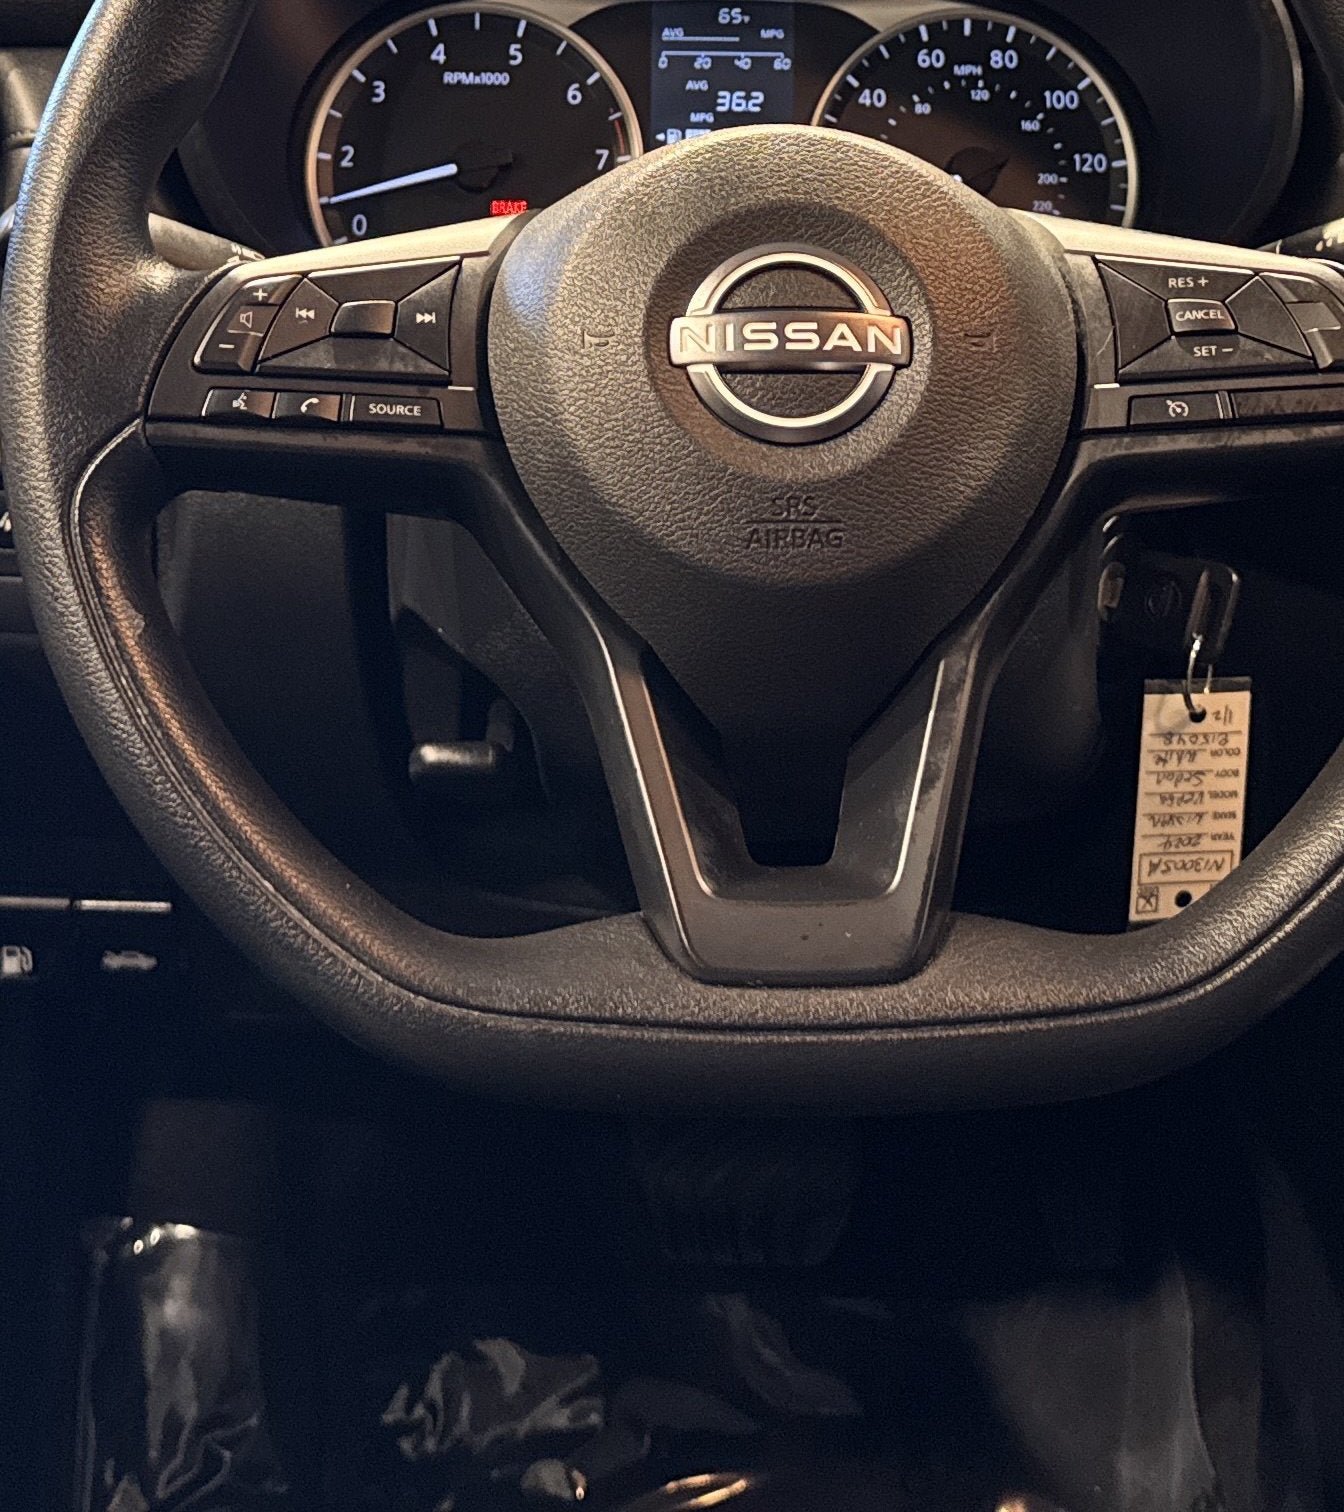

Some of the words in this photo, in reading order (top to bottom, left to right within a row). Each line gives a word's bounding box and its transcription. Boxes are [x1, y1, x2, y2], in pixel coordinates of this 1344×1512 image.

[662, 27, 684, 38] AVG
[760, 28, 785, 39] MPG
[430, 43, 446, 65] 4
[509, 43, 523, 66] 5
[917, 48, 945, 69] 60
[989, 48, 1019, 70] 80
[658, 57, 669, 69] 0
[694, 57, 712, 70] 20
[734, 57, 752, 70] 40
[773, 57, 792, 70] 60
[953, 64, 982, 76] MPH
[371, 80, 386, 103] 3
[685, 80, 709, 91] AVG
[567, 82, 582, 105] 6
[858, 88, 887, 108] 40
[970, 90, 990, 101] 120
[1043, 89, 1080, 110] 100
[914, 103, 932, 115] 80
[690, 112, 715, 123] MPG
[1020, 119, 1041, 132] 160
[341, 145, 355, 168] 2
[595, 149, 609, 170] 7
[1073, 153, 1107, 173] 120
[1037, 173, 1058, 185] 200
[1032, 200, 1053, 212] 220
[352, 214, 367, 236] 0
[1168, 276, 1195, 289] RES
[1175, 308, 1225, 322] CANCEL
[678, 321, 903, 355] NISSAN
[1193, 345, 1217, 357] SET
[368, 402, 422, 416] SOURCE
[771, 494, 817, 519] SRS
[745, 527, 844, 549] AIRBAG
[1210, 748, 1240, 757] COLOR
[1210, 832, 1235, 841] YEAR
